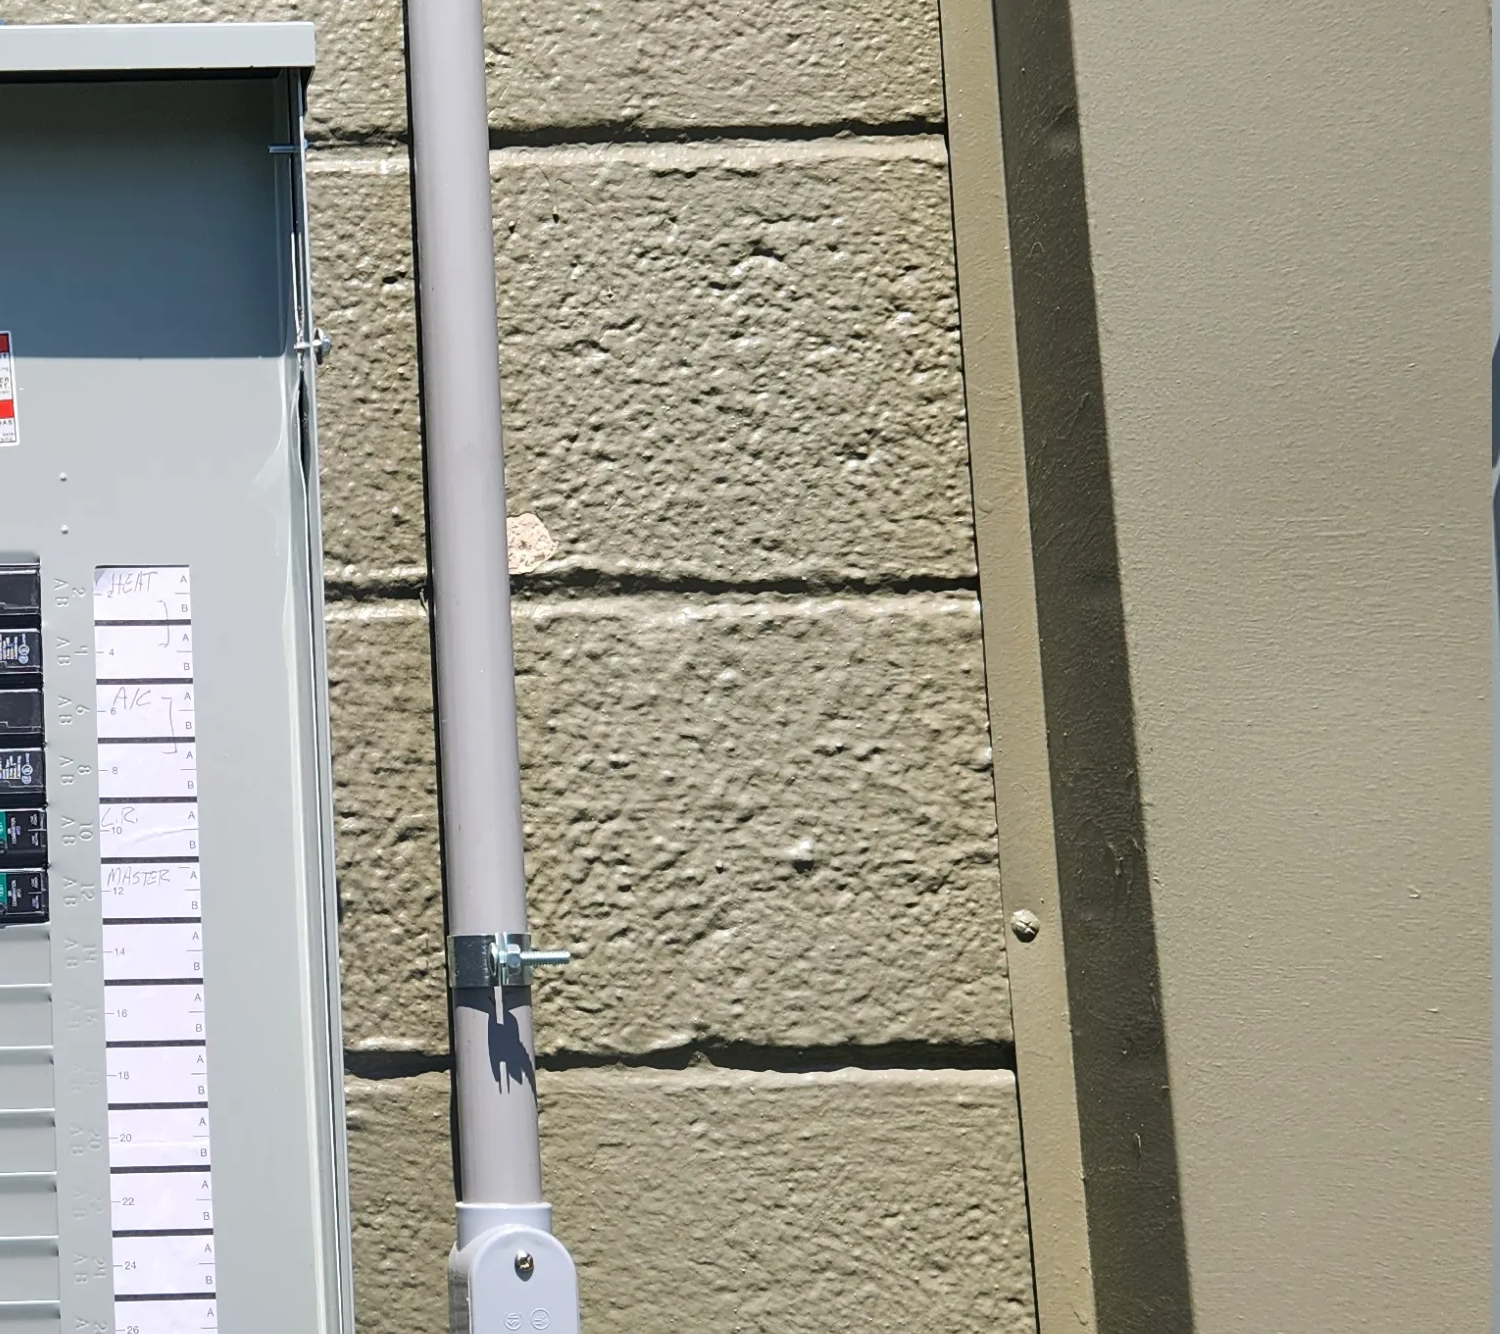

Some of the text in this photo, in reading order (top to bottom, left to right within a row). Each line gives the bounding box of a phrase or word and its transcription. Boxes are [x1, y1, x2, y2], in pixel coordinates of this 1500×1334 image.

[111, 570, 158, 595] HEAT
[112, 686, 151, 710] A/C
[80, 822, 93, 841] 10
[107, 866, 171, 887] MASTER
[113, 887, 124, 895] 12
[114, 948, 125, 956] 14
[116, 1009, 128, 1017] 16
[118, 1071, 130, 1079] 18
[120, 1134, 132, 1142] 20
[122, 1197, 135, 1205] 22
[124, 1261, 137, 1270] 24
[126, 1326, 140, 1334] 26
